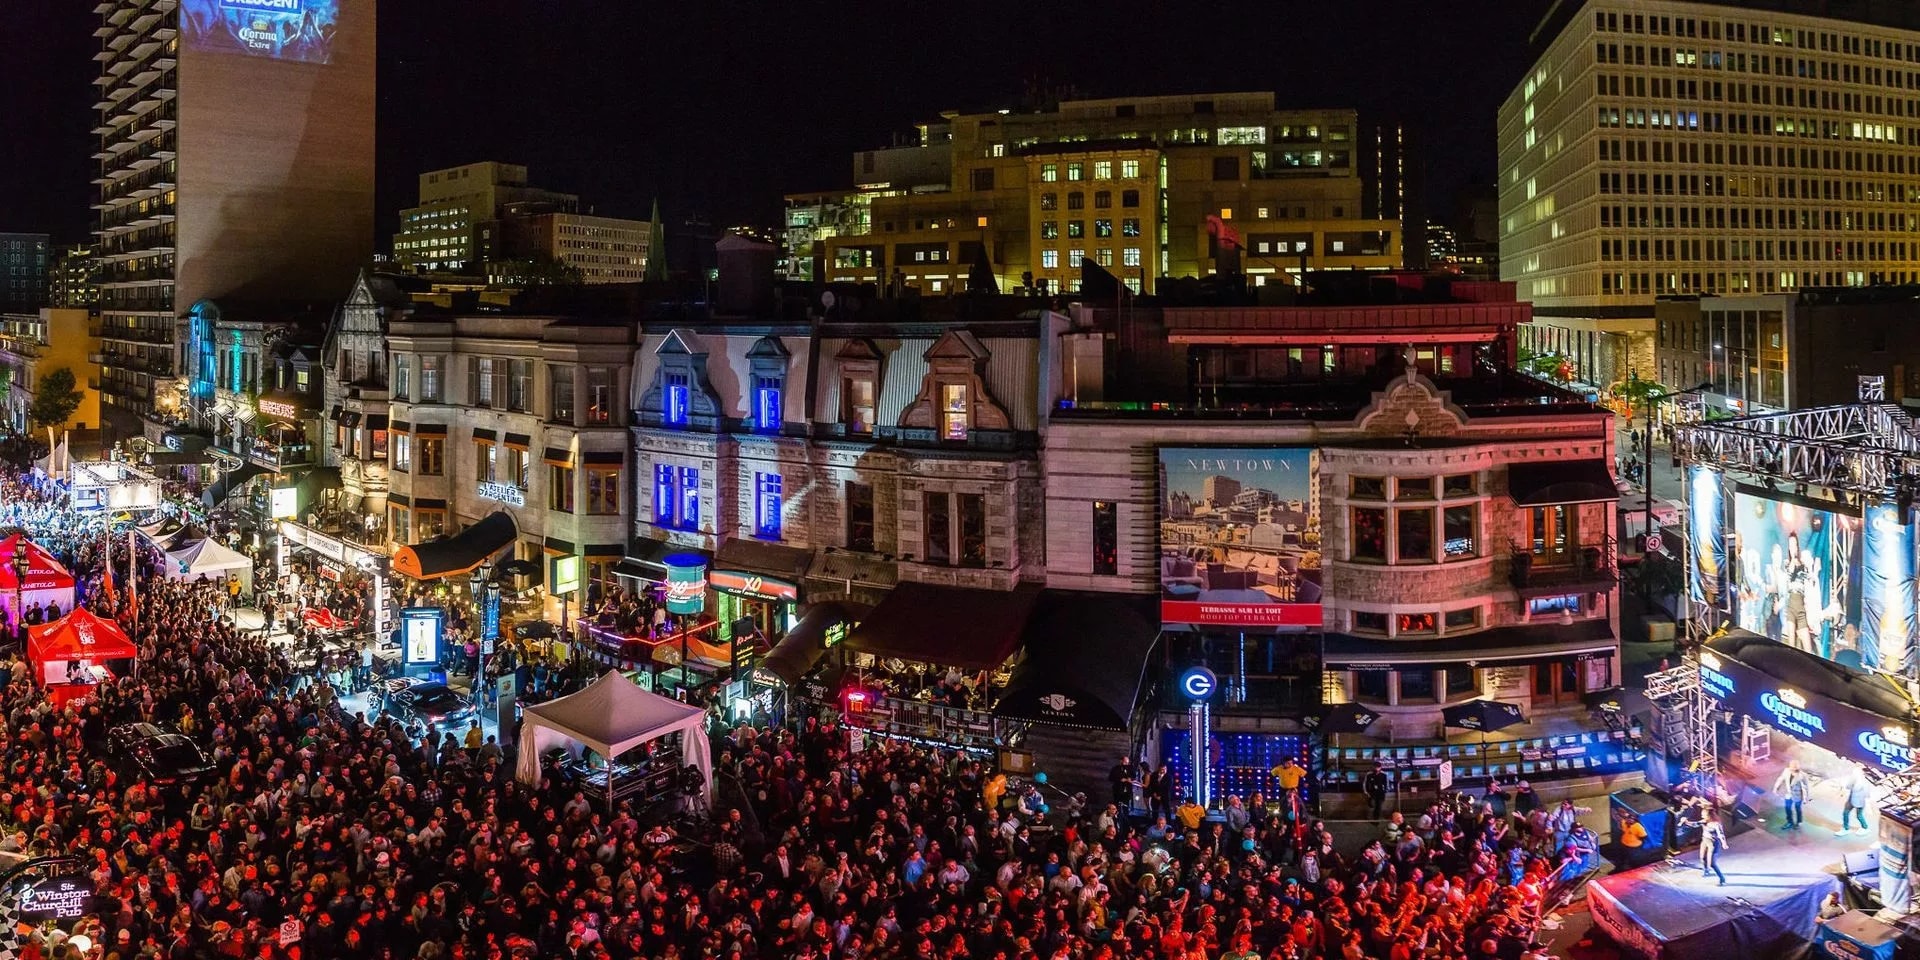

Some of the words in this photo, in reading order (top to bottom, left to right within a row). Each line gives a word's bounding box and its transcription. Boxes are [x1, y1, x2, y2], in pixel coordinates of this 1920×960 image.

[239, 27, 277, 40] Corona
[249, 41, 270, 49] Extra
[1188, 459, 1290, 471] NEWTOWN
[669, 580, 689, 595] XO
[743, 577, 762, 594] XO
[1760, 692, 1825, 732] Corona
[1777, 713, 1813, 738] Extra
[61, 883, 75, 891] Sir
[36, 890, 91, 901] Winston
[22, 897, 82, 912] Churchill
[57, 907, 82, 918] Pub
